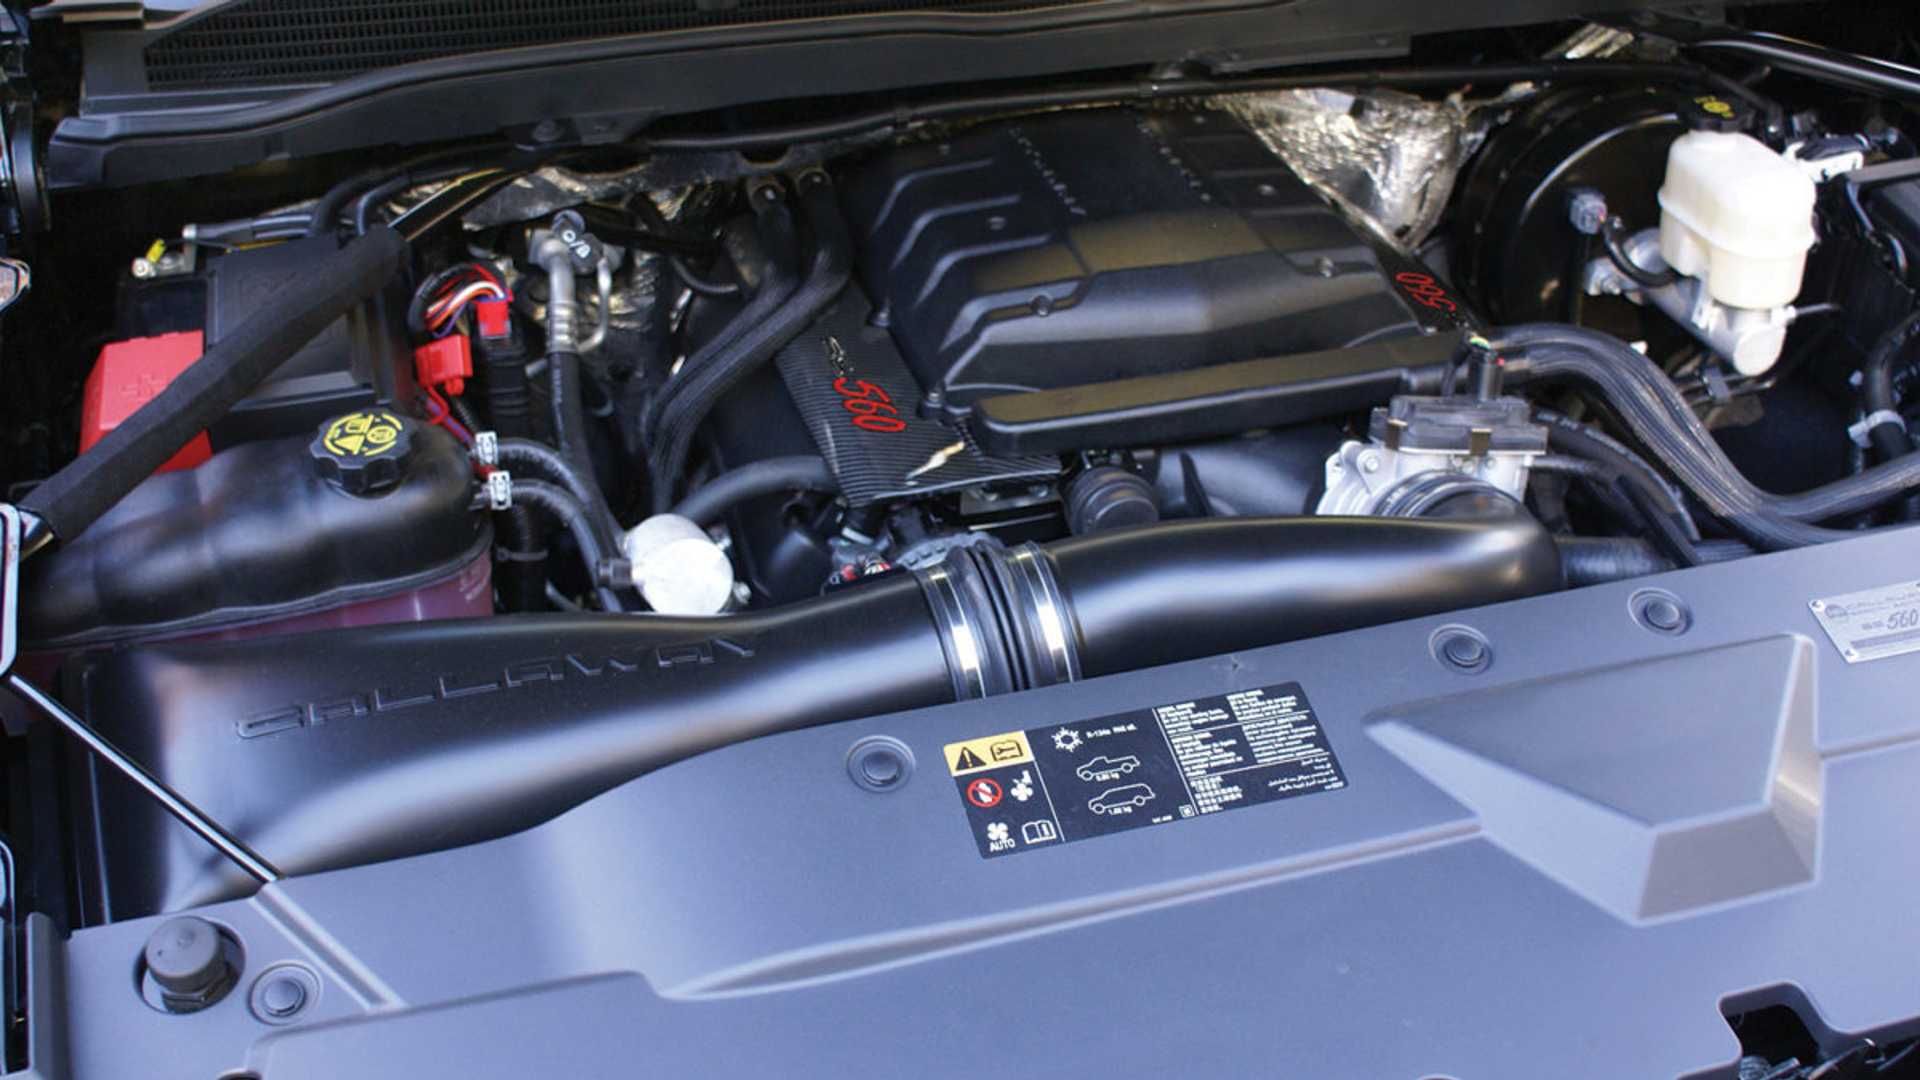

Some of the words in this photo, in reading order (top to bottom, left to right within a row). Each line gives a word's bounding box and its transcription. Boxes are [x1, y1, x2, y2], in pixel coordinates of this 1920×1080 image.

[1395, 271, 1457, 313] 560
[832, 376, 907, 433] 560
[1886, 608, 1919, 630] 560
[235, 635, 757, 741] CALLAWAY
[989, 838, 1016, 852] AUTO
